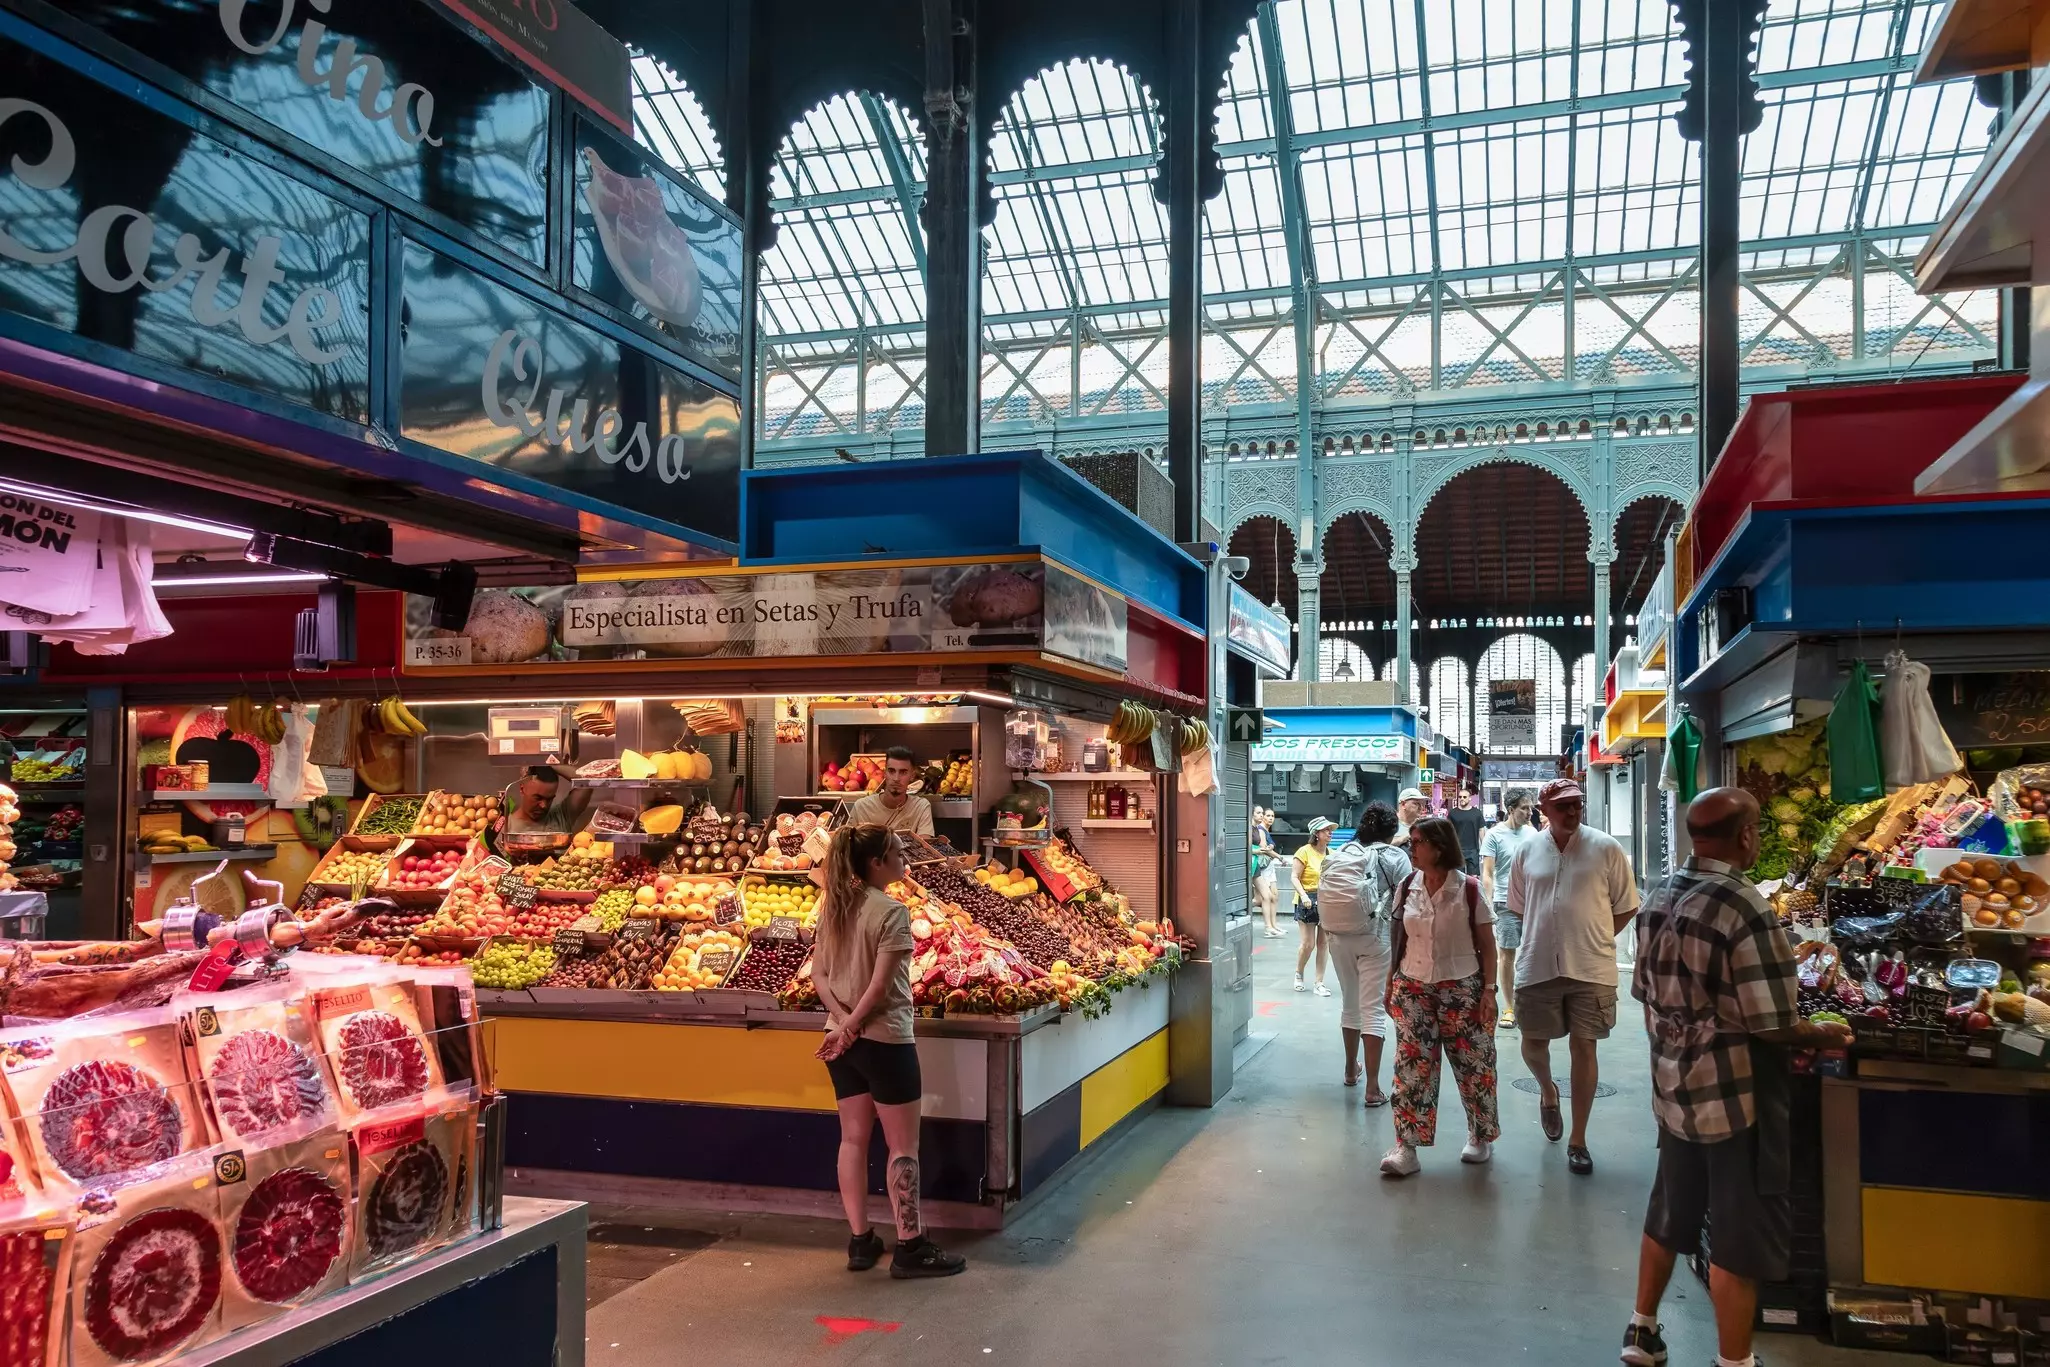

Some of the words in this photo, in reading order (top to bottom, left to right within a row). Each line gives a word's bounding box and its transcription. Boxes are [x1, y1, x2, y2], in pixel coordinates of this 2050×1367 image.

[0, 98, 350, 364] Corte
[482, 328, 691, 484] Queso
[37, 506, 76, 530] DEL
[569, 602, 707, 637] Especialista
[716, 607, 745, 625] en
[754, 599, 818, 624] Setas
[825, 603, 842, 629] y
[850, 593, 922, 620] Trufa
[944, 634, 964, 648] Tel.
[415, 646, 425, 660] P.
[428, 645, 462, 660] 35-36
[1305, 738, 1400, 749] FRESCOS
[1314, 749, 1325, 760] Y
[1329, 749, 1382, 760] LUCAS
[515, 884, 538, 895] TOMATE
